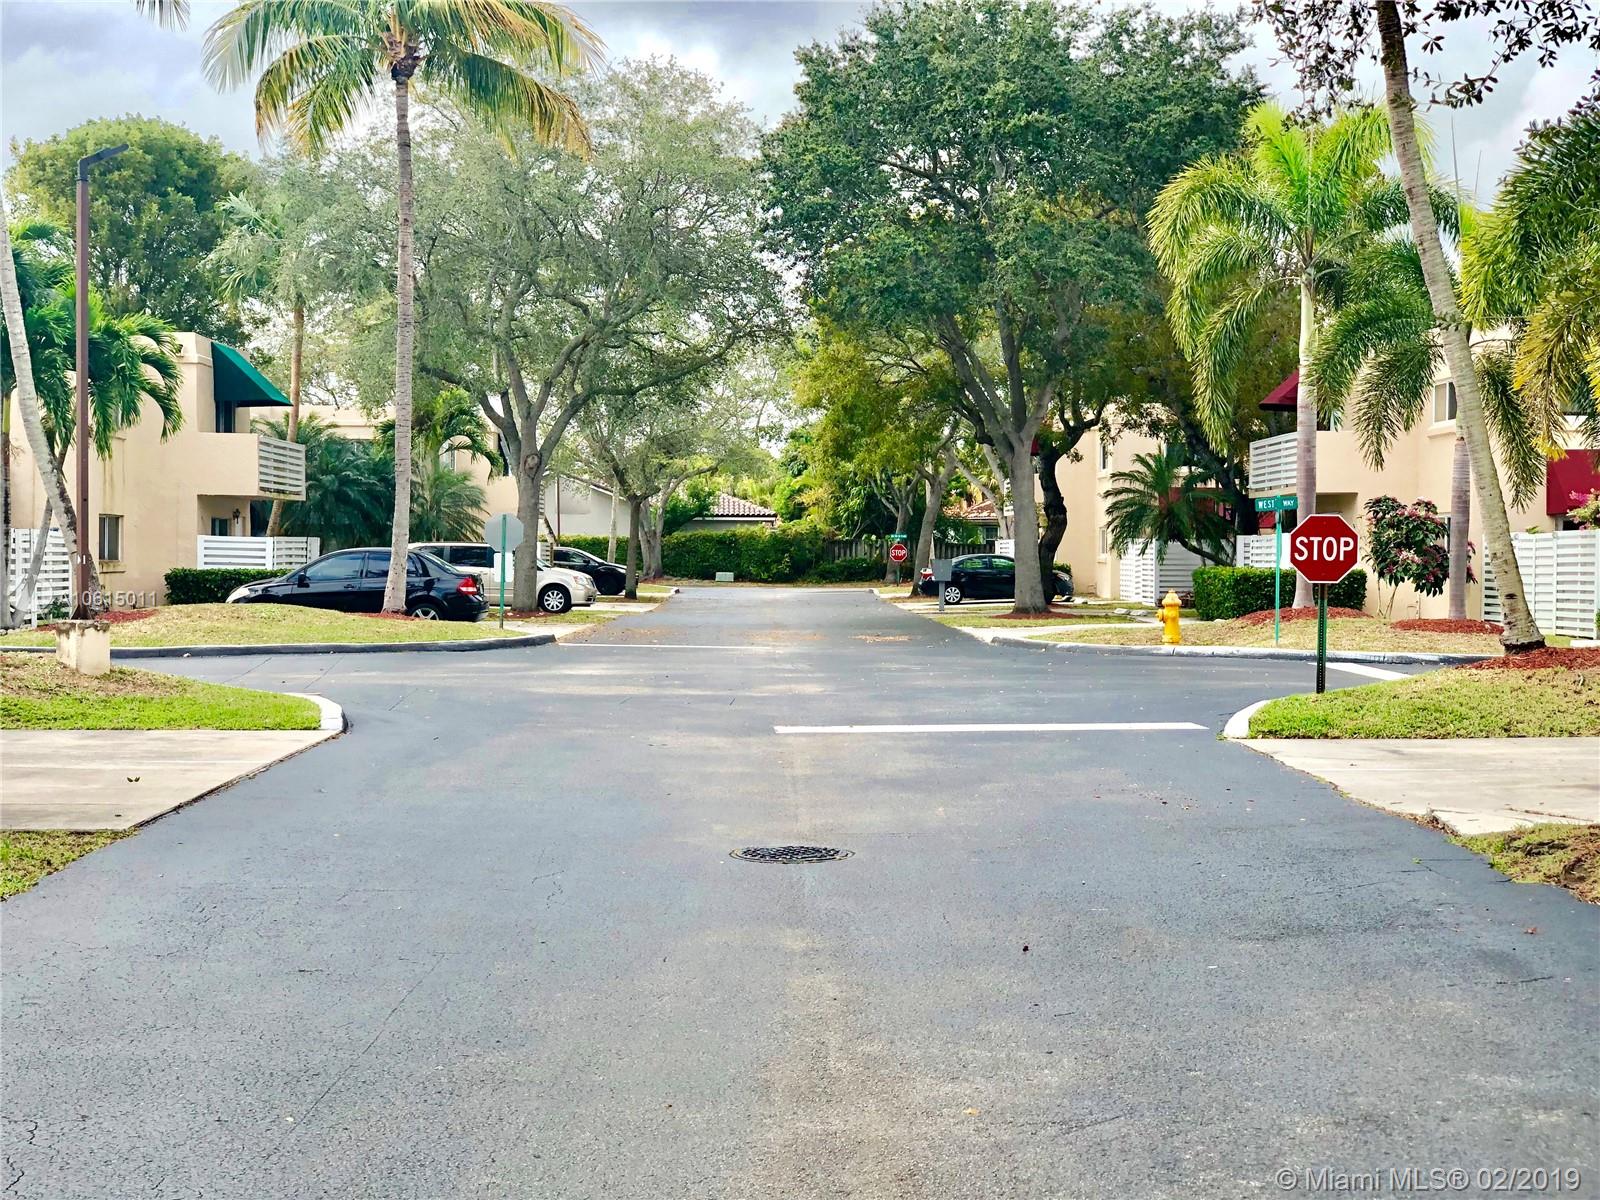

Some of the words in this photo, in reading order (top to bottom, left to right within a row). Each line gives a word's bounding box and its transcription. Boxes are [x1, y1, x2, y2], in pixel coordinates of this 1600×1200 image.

[1258, 499, 1274, 509] WEST
[1282, 499, 1295, 507] WAY
[891, 549, 906, 557] STOP
[1294, 536, 1354, 561] STOP
